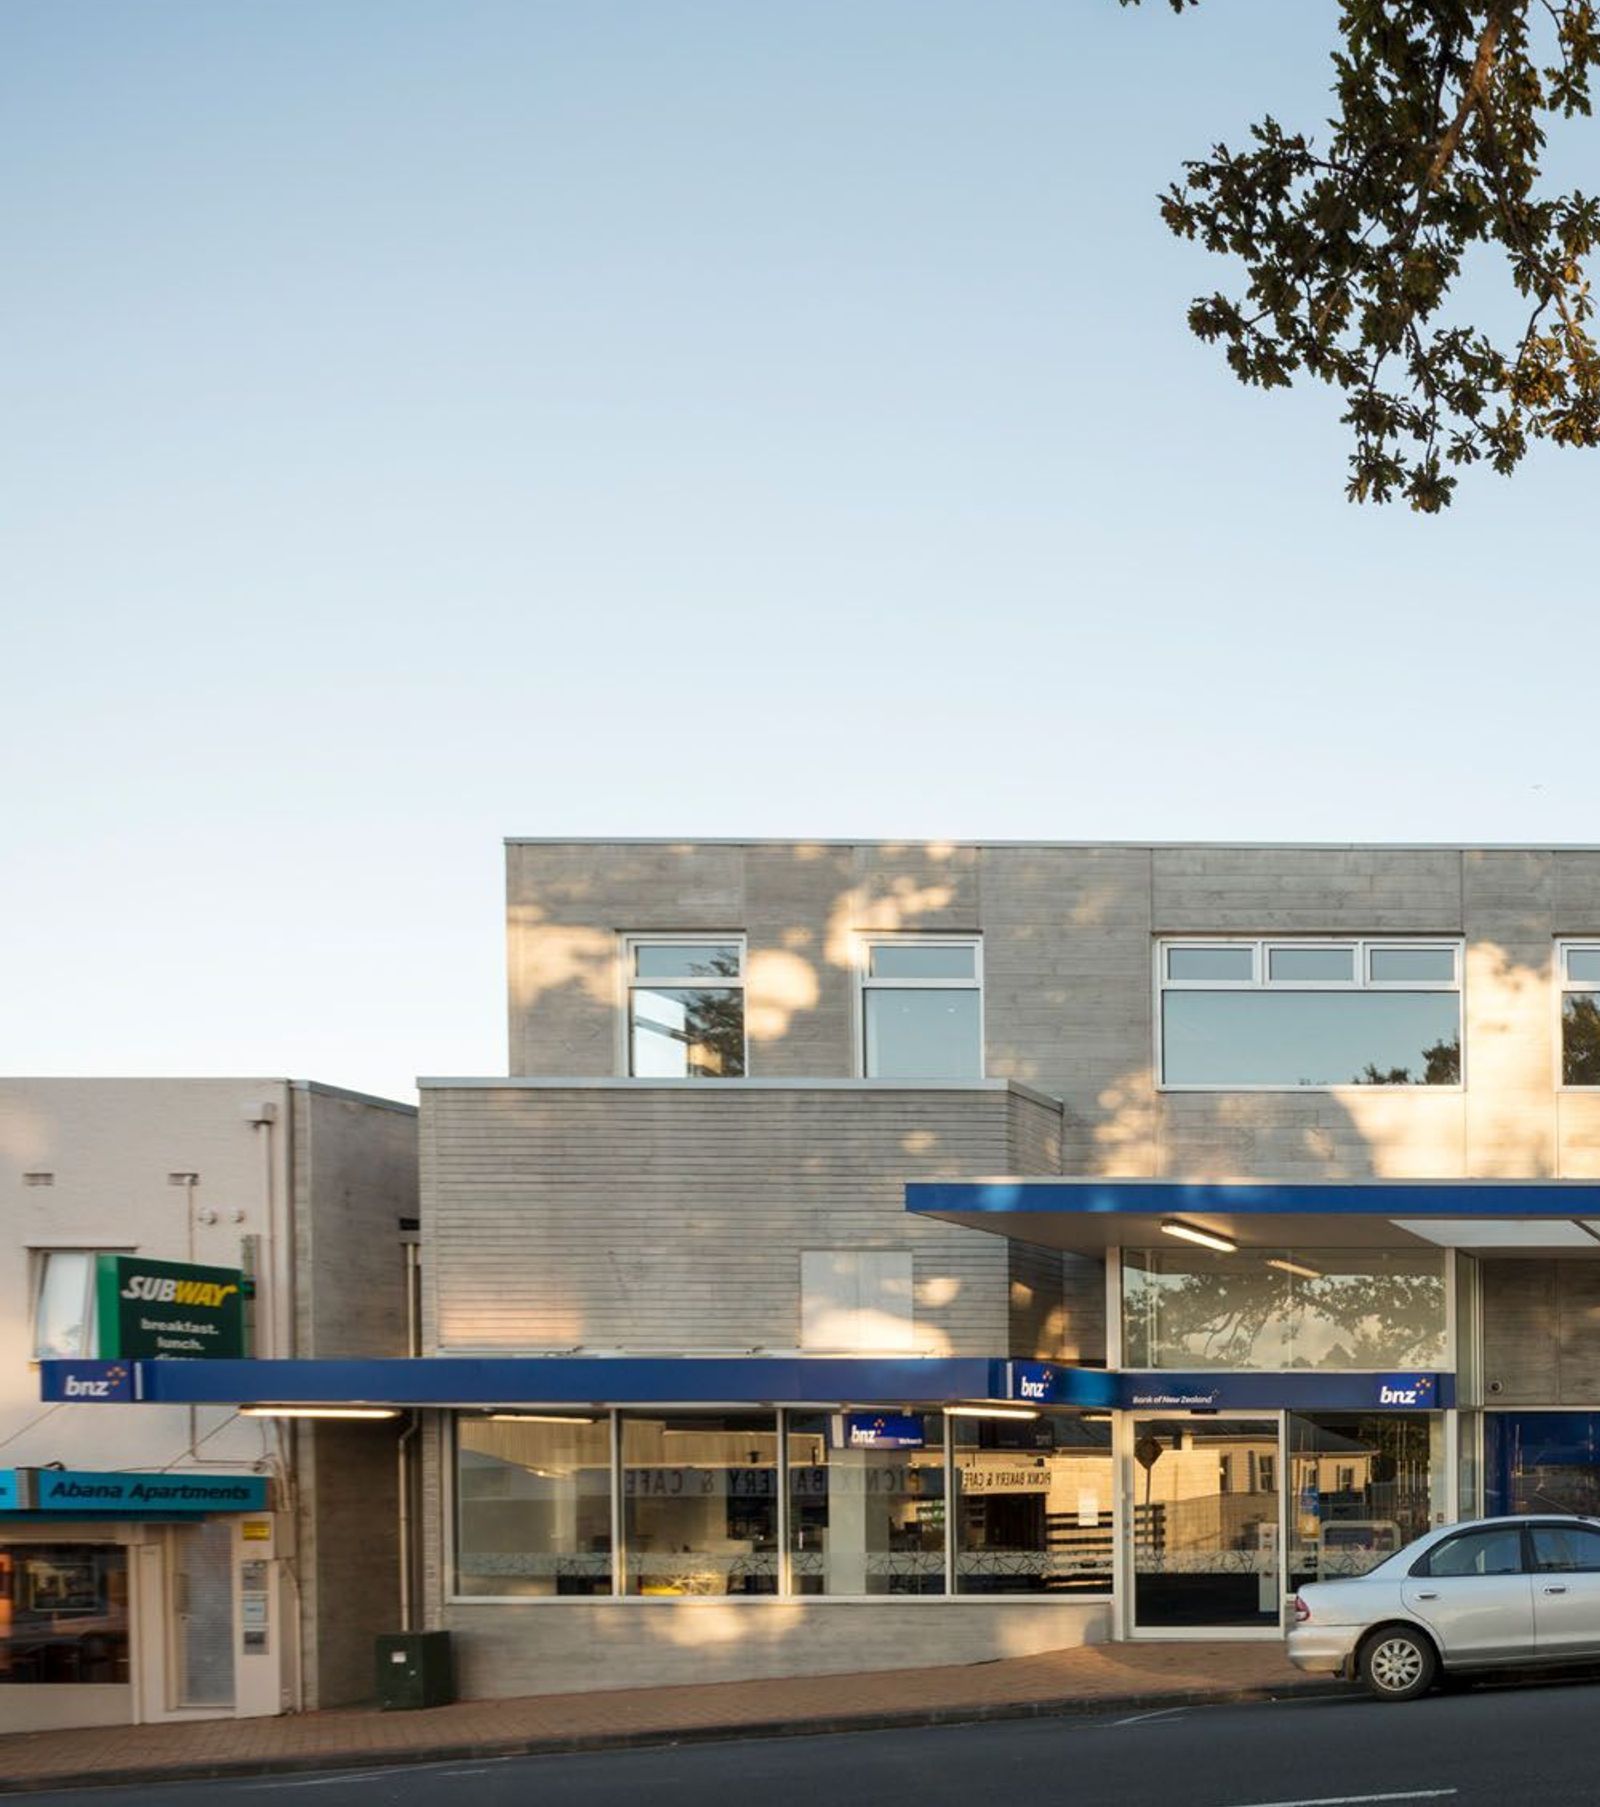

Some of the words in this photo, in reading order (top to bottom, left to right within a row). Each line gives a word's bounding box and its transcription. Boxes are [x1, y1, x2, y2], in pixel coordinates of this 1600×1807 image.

[121, 1276, 238, 1307] SUBWAY
[65, 1375, 109, 1396] bnz
[1021, 1376, 1044, 1397] bnz
[1380, 1386, 1417, 1404] bnz
[851, 1424, 876, 1443] bnz
[51, 1481, 124, 1499] Abana
[129, 1483, 250, 1502] Apartments
